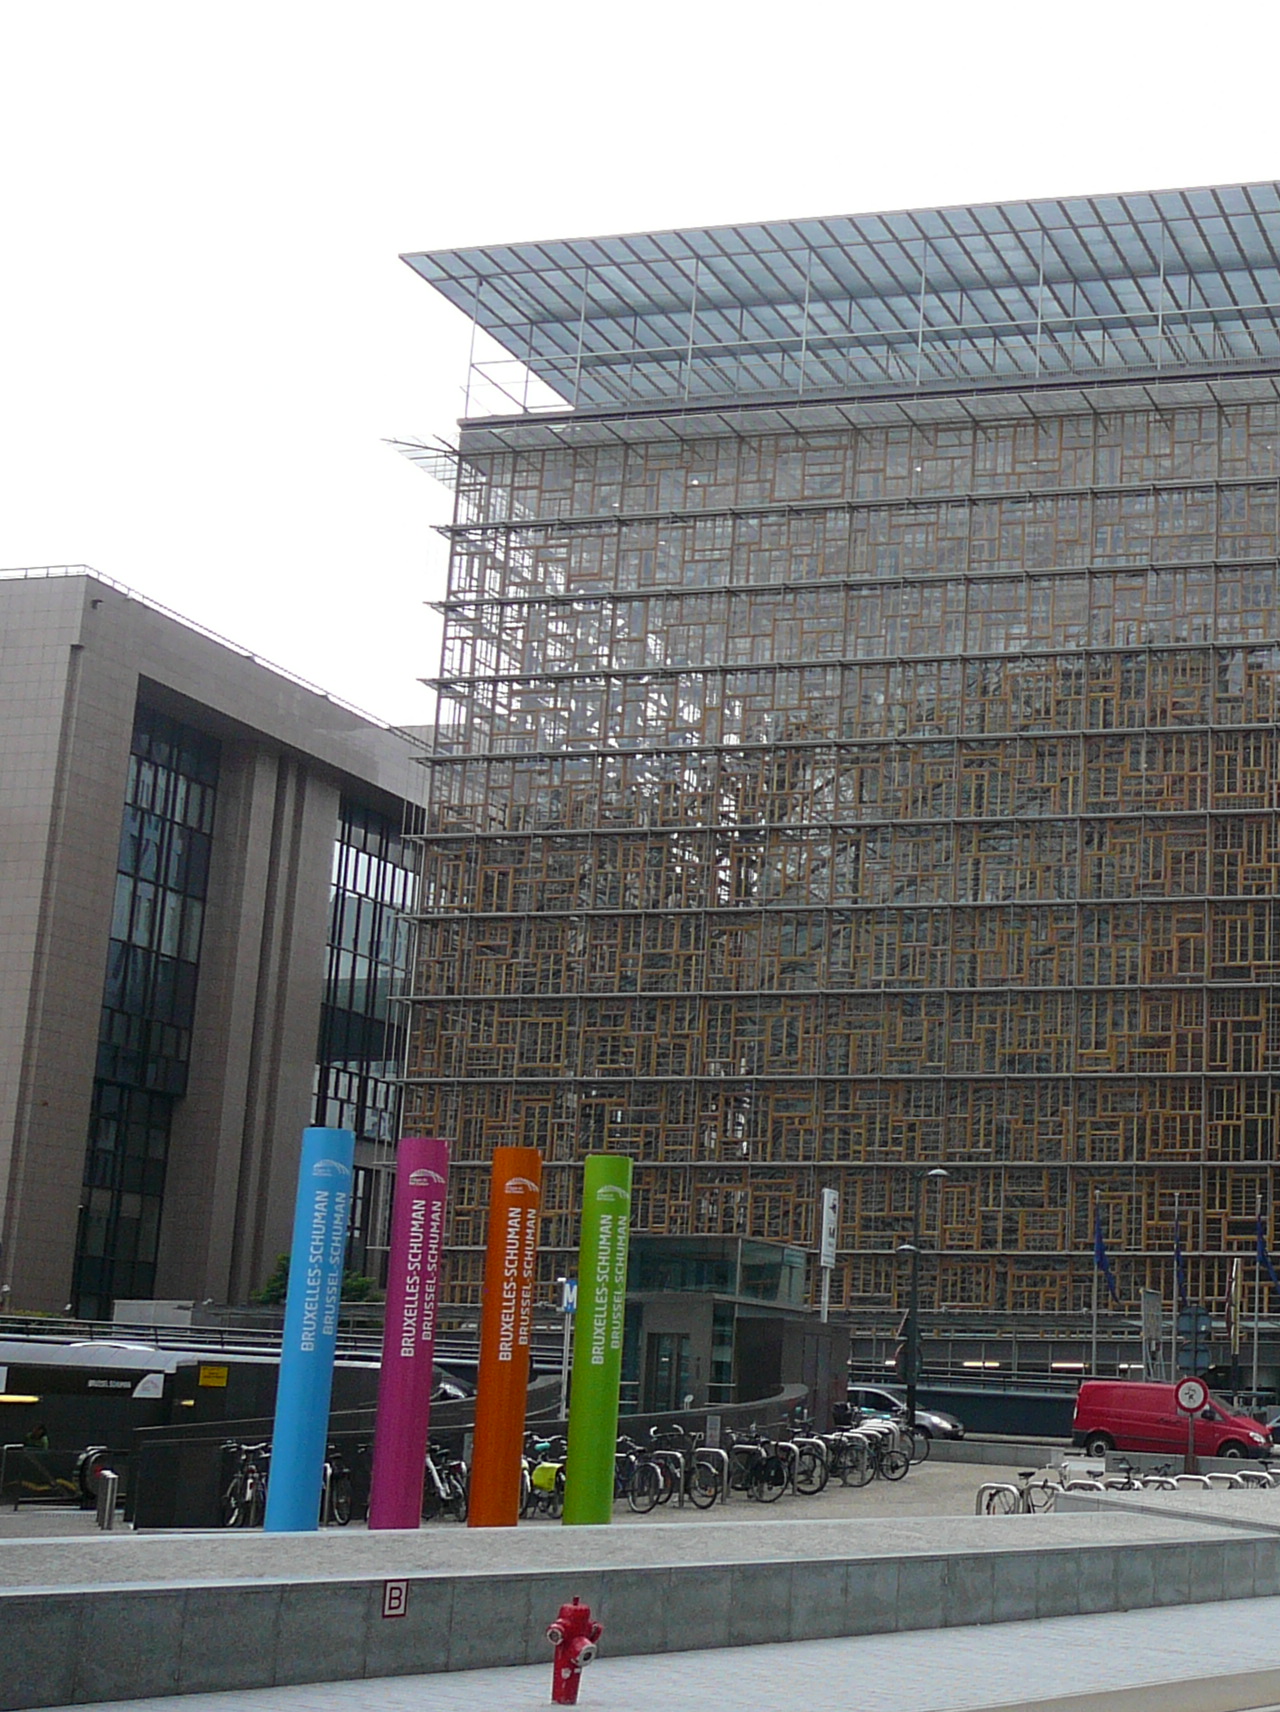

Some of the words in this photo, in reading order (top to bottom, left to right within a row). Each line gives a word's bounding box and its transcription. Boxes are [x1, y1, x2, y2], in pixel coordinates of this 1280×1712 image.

[300, 1190, 329, 1352] BRUXELLES-SCHUMAN
[322, 1192, 346, 1336] BRUSSEL-SCHUMAN
[400, 1199, 426, 1357] BRUXELLES-SCHUMAN
[421, 1200, 442, 1341] BRUSSEL-SCHUMAN
[498, 1207, 522, 1361] BRUXELLES-SCHUMAN
[518, 1208, 537, 1346] BRUSSEL-SCHUMAN
[563, 1282, 578, 1309] M
[591, 1214, 613, 1365] BRUXELLES-SCHUMAN
[610, 1215, 627, 1349] BRUSSEL-SCHUMAN
[388, 1586, 403, 1610] B
